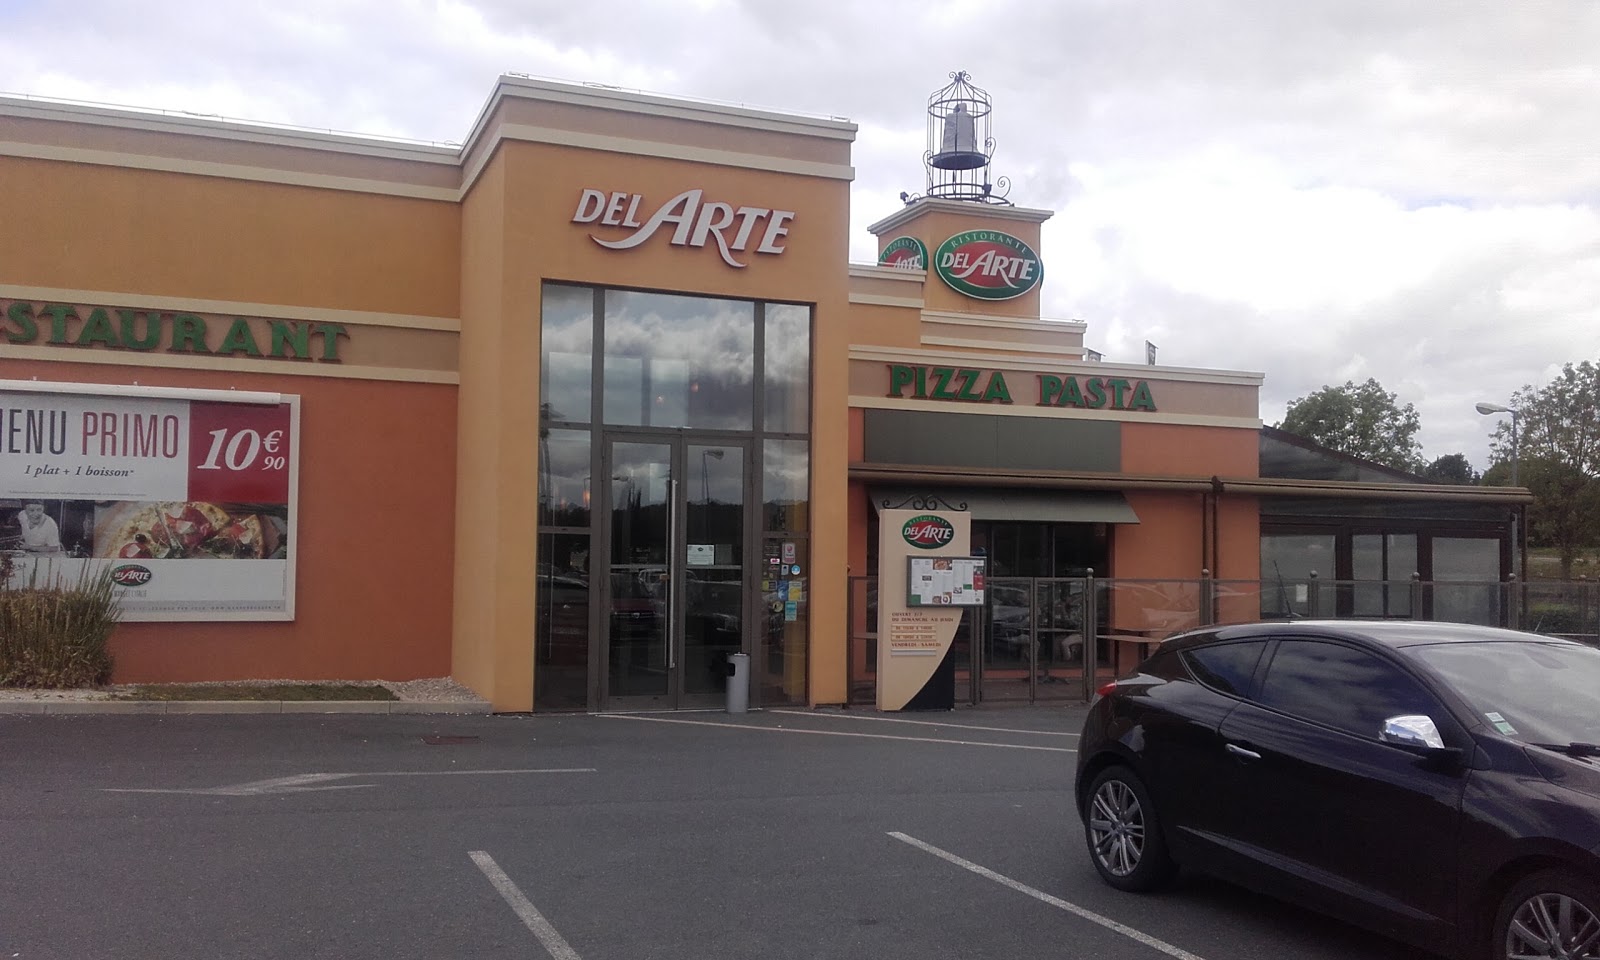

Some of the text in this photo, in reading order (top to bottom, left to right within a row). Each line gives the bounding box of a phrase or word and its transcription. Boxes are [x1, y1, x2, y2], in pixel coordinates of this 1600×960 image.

[572, 188, 796, 269] DEL ARTE
[951, 231, 1027, 253] RISTORANTE
[940, 250, 1035, 289] DEL ARTE
[0, 302, 351, 362] STAURANT
[886, 364, 1158, 412] PIZZA PASTA
[0, 408, 179, 458] ENU PRIMO
[197, 428, 260, 471] 10
[262, 456, 286, 471] 90
[24, 464, 31, 475] 1
[34, 464, 60, 478] plat
[75, 466, 82, 476] 1
[904, 525, 952, 544] DEL ARTE
[117, 570, 150, 583] ARTE
